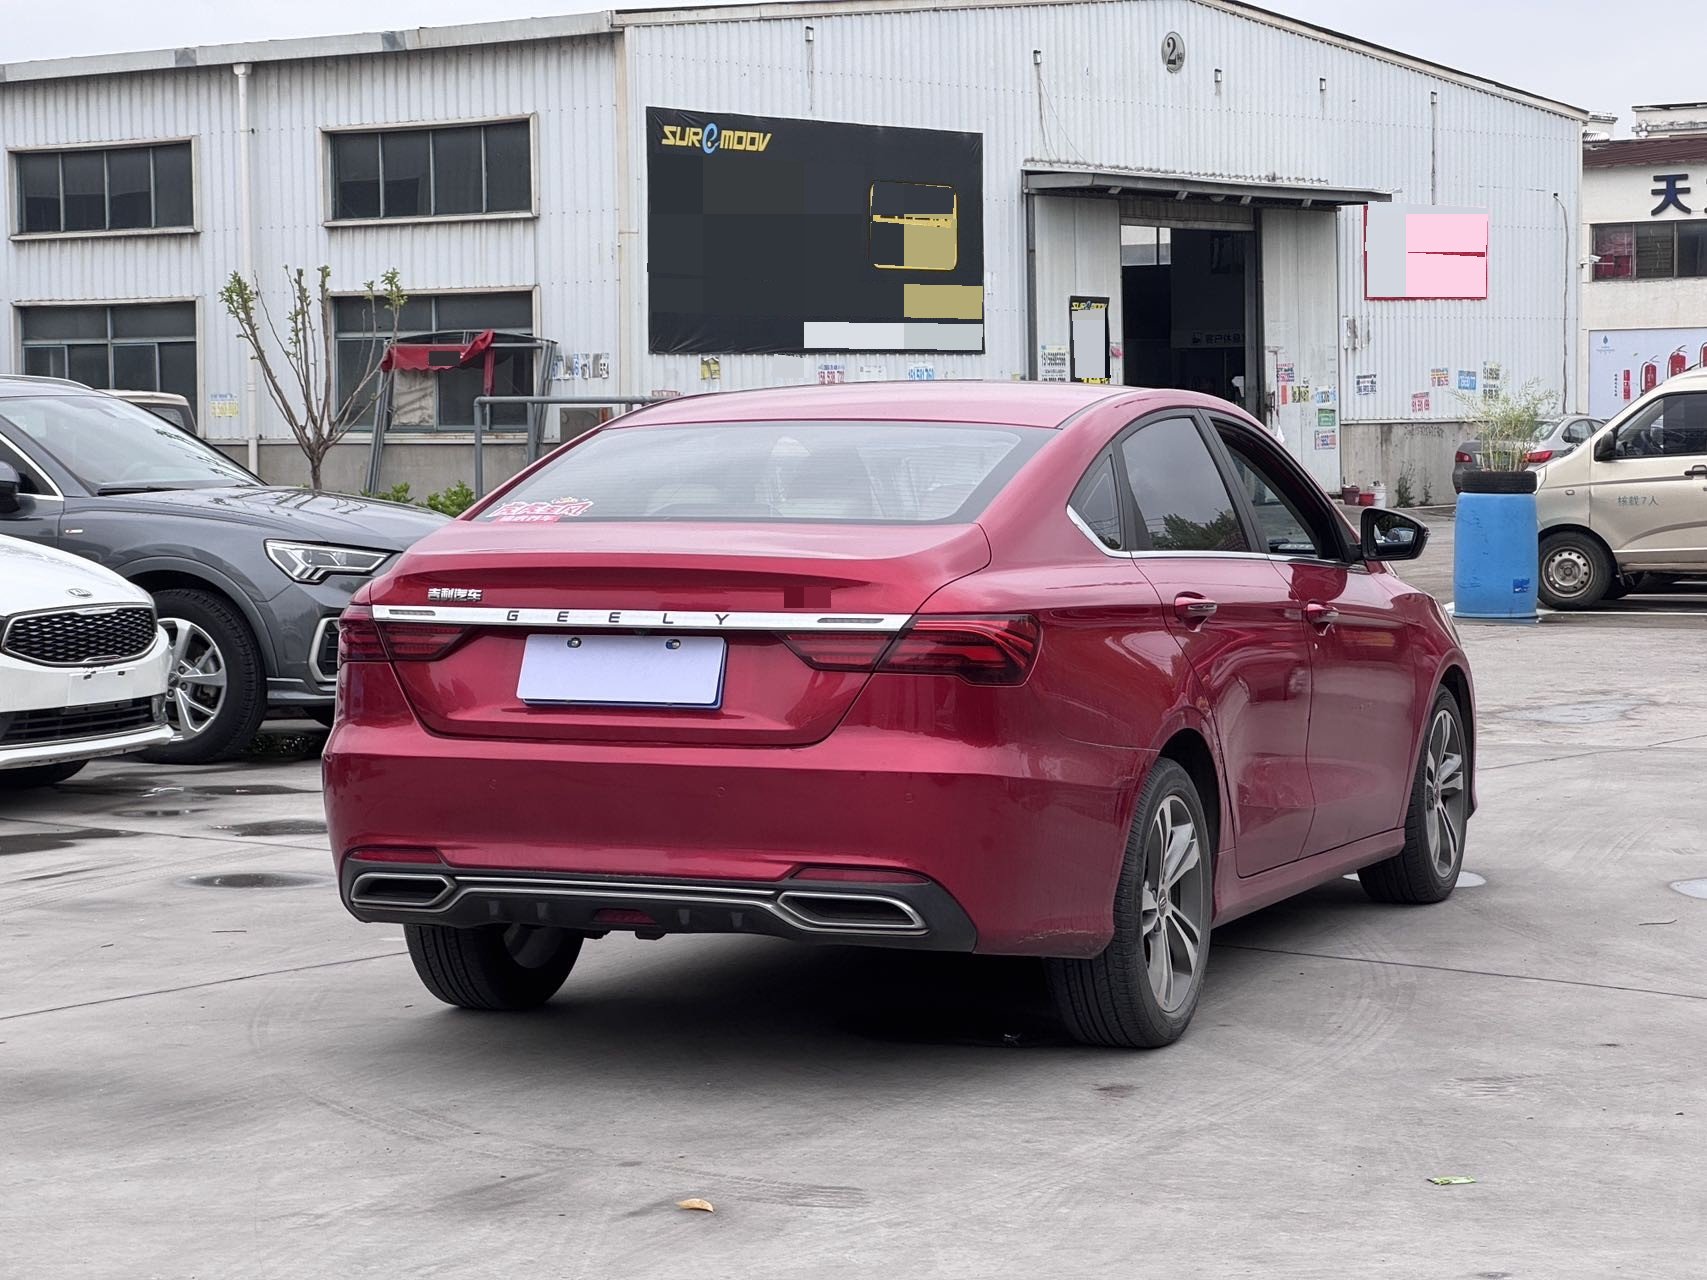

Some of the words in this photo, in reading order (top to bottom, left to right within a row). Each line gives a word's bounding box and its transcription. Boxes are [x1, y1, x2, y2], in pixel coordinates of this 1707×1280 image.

[1651, 173, 1707, 216] 天
[427, 587, 483, 601] 吉利汽车
[506, 610, 730, 626] GEELY
